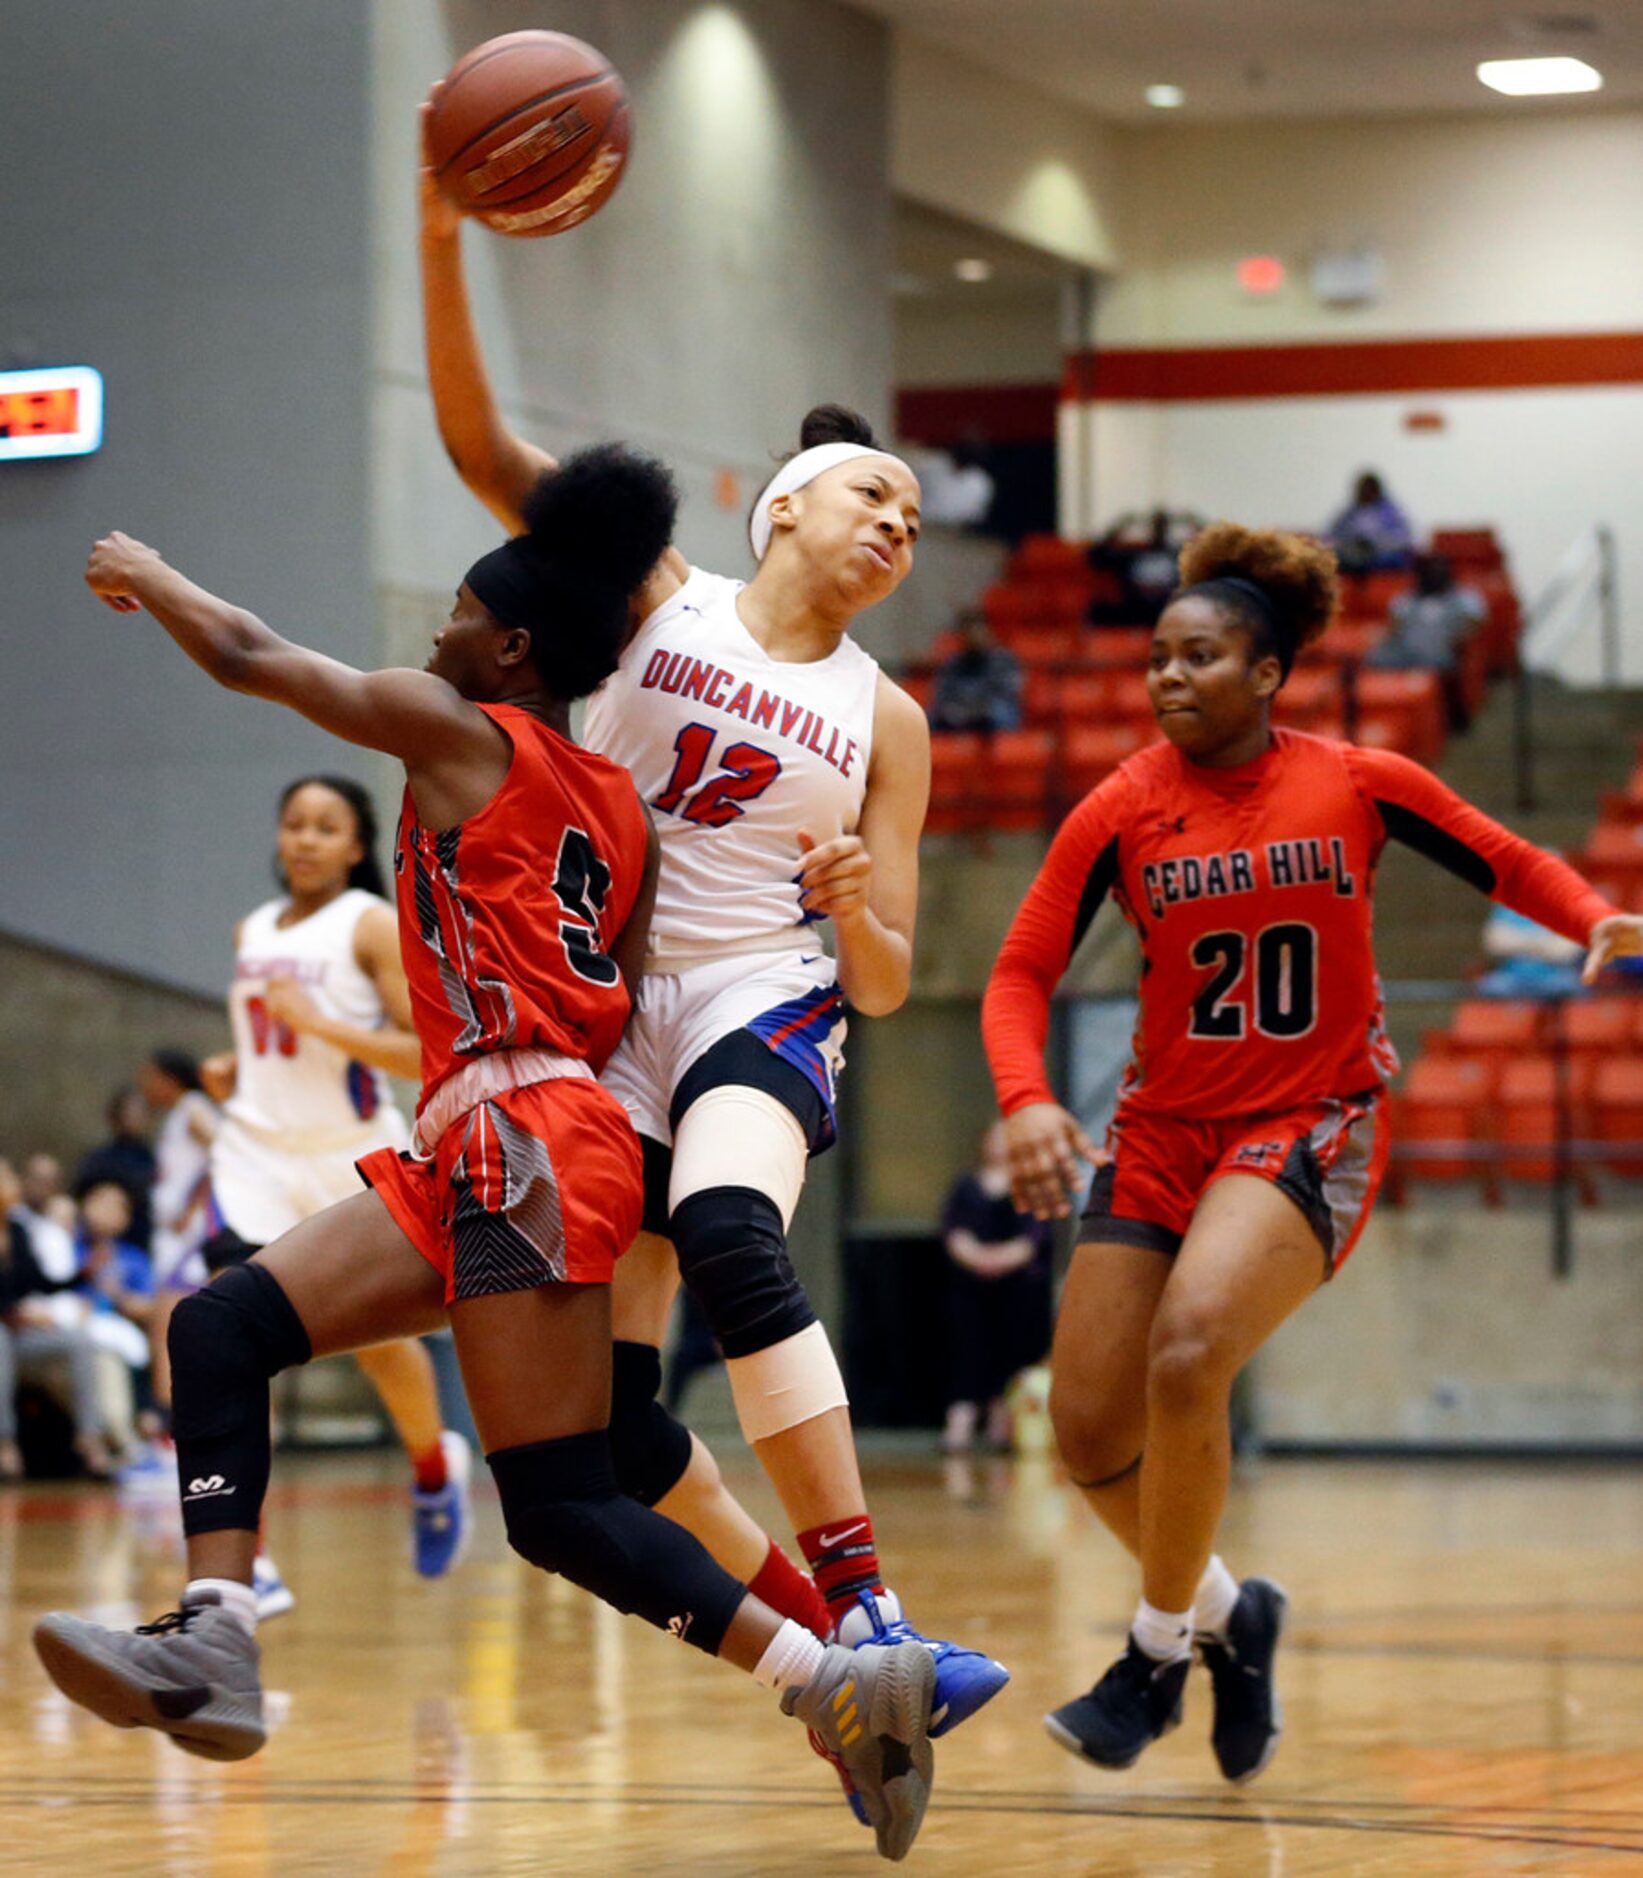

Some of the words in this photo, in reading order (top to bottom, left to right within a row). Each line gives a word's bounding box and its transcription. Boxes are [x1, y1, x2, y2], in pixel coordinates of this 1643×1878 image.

[640, 648, 857, 778] DUNCANVILLE
[650, 721, 782, 828] 12
[1142, 850, 1255, 920] CEDAR
[1264, 836, 1355, 898] HILL
[1187, 920, 1319, 1041] 20
